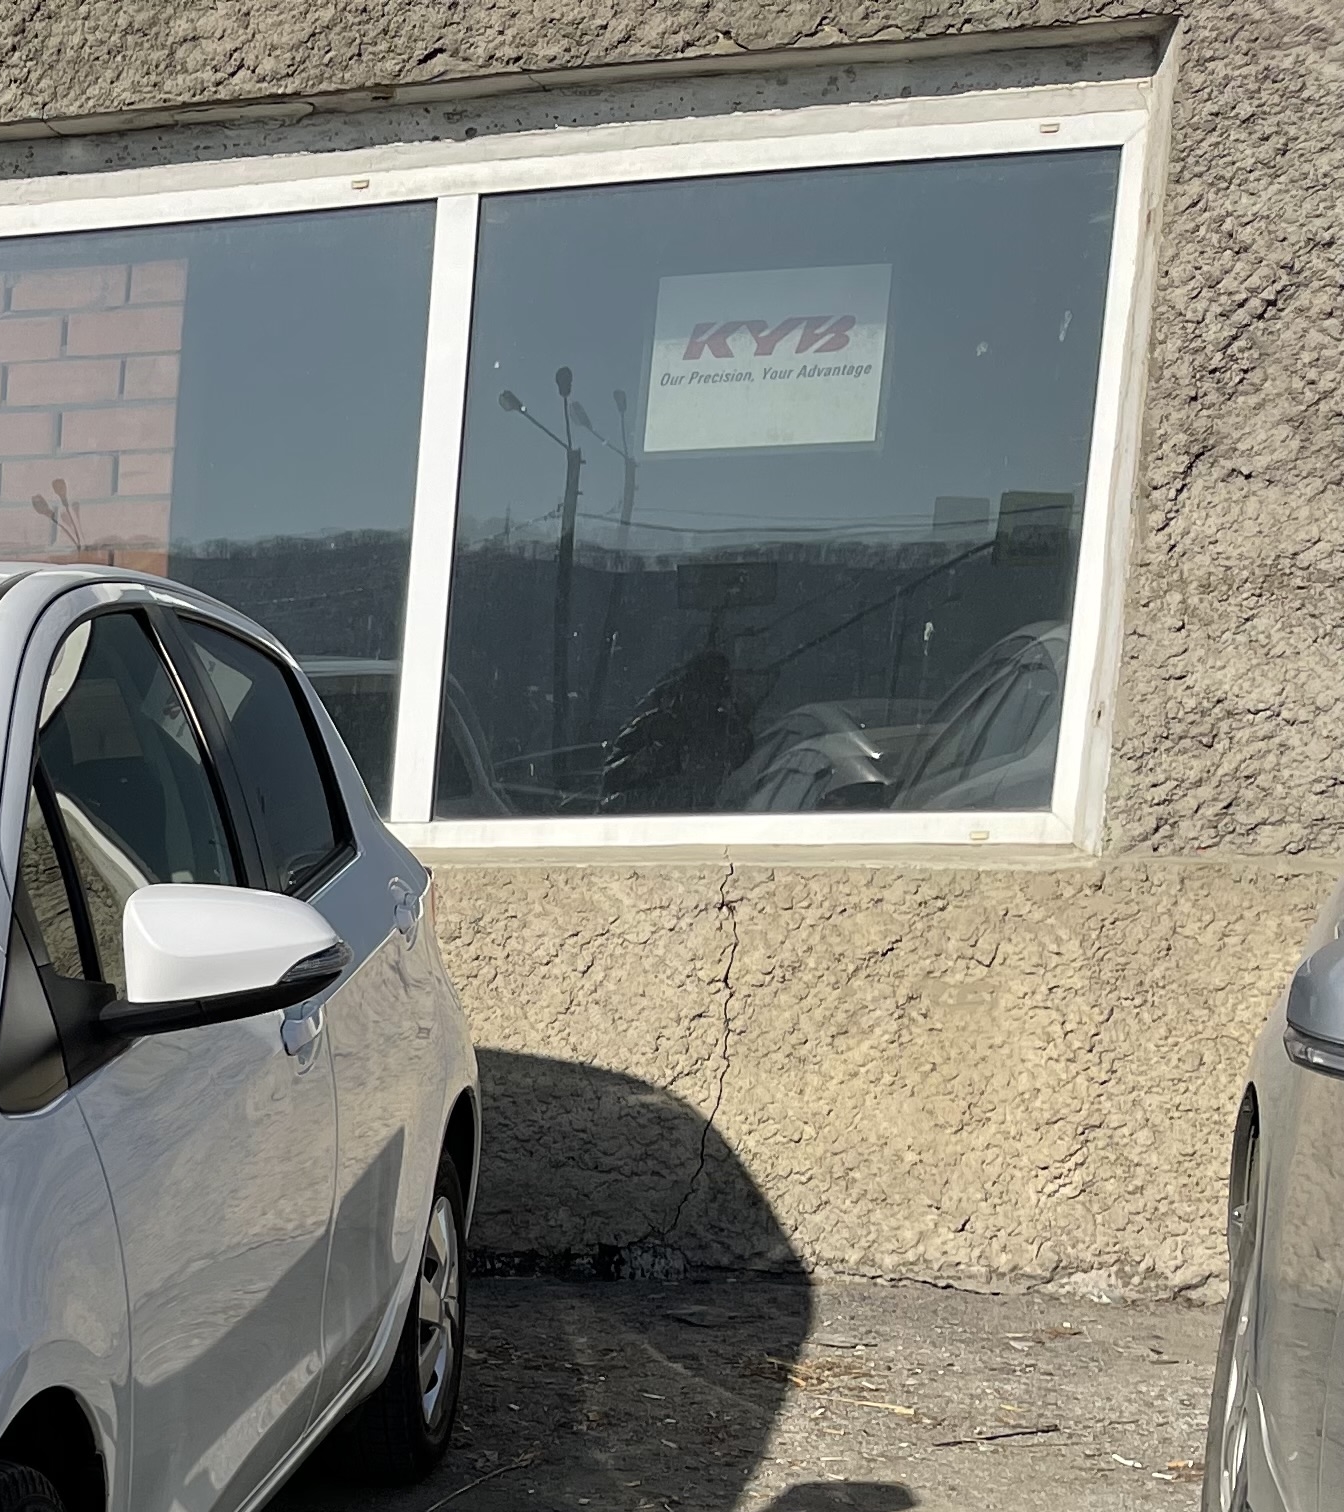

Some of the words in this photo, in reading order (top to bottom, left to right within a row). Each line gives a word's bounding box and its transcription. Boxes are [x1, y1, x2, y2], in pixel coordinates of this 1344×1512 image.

[682, 315, 856, 360] KYB
[660, 373, 686, 386] Our
[688, 370, 755, 385] Precision,
[762, 367, 793, 381] Your
[796, 364, 872, 379] Advantage
